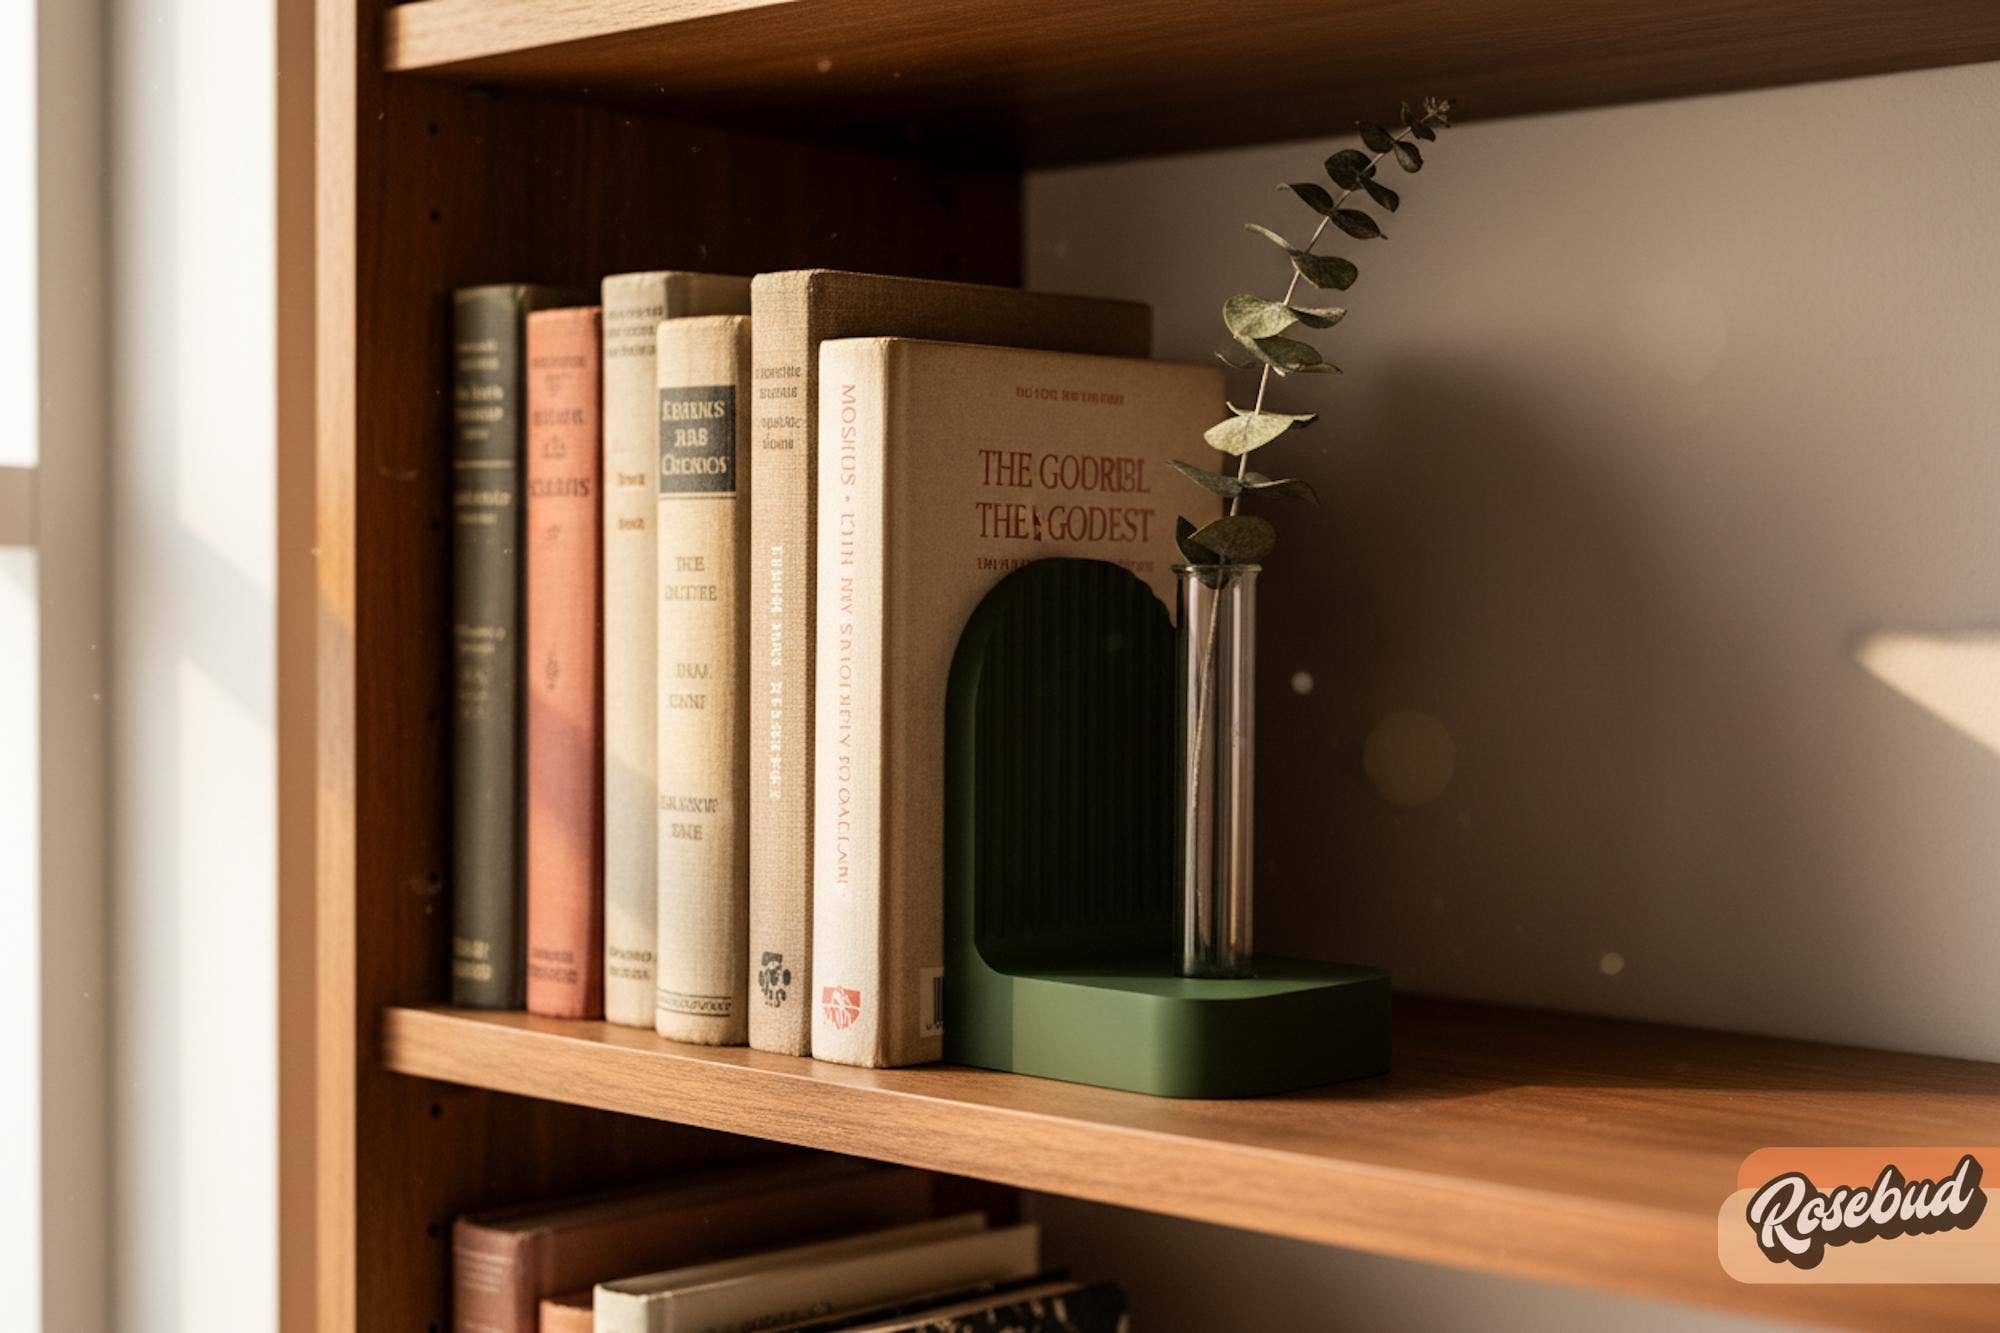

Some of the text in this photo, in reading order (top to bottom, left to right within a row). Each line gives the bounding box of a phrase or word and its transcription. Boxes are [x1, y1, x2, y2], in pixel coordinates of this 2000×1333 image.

[978, 449, 1033, 488] THE
[975, 502, 1155, 543] THE GODEST
